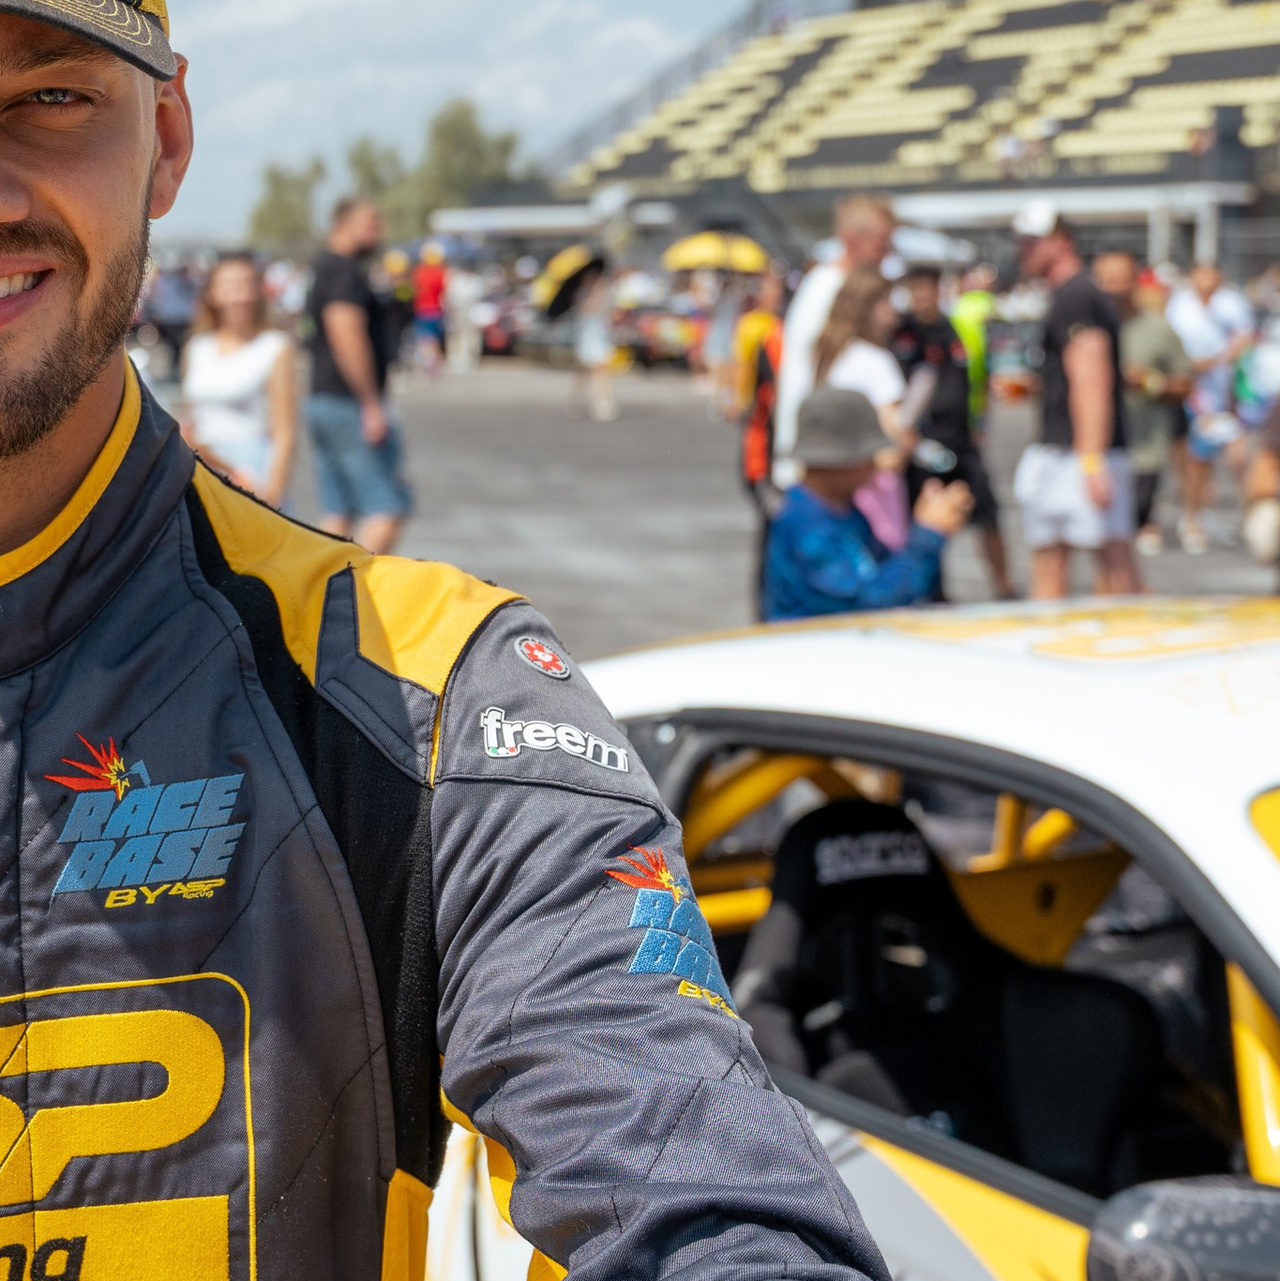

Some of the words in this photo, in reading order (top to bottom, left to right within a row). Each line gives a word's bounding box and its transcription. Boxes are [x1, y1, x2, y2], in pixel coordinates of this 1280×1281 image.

[482, 708, 628, 772] freem
[57, 773, 245, 844] RACE
[51, 822, 246, 898] BASE
[105, 884, 172, 908] BY
[168, 878, 226, 896] ASP
[627, 887, 718, 957] RA
[627, 927, 739, 1013] BA
